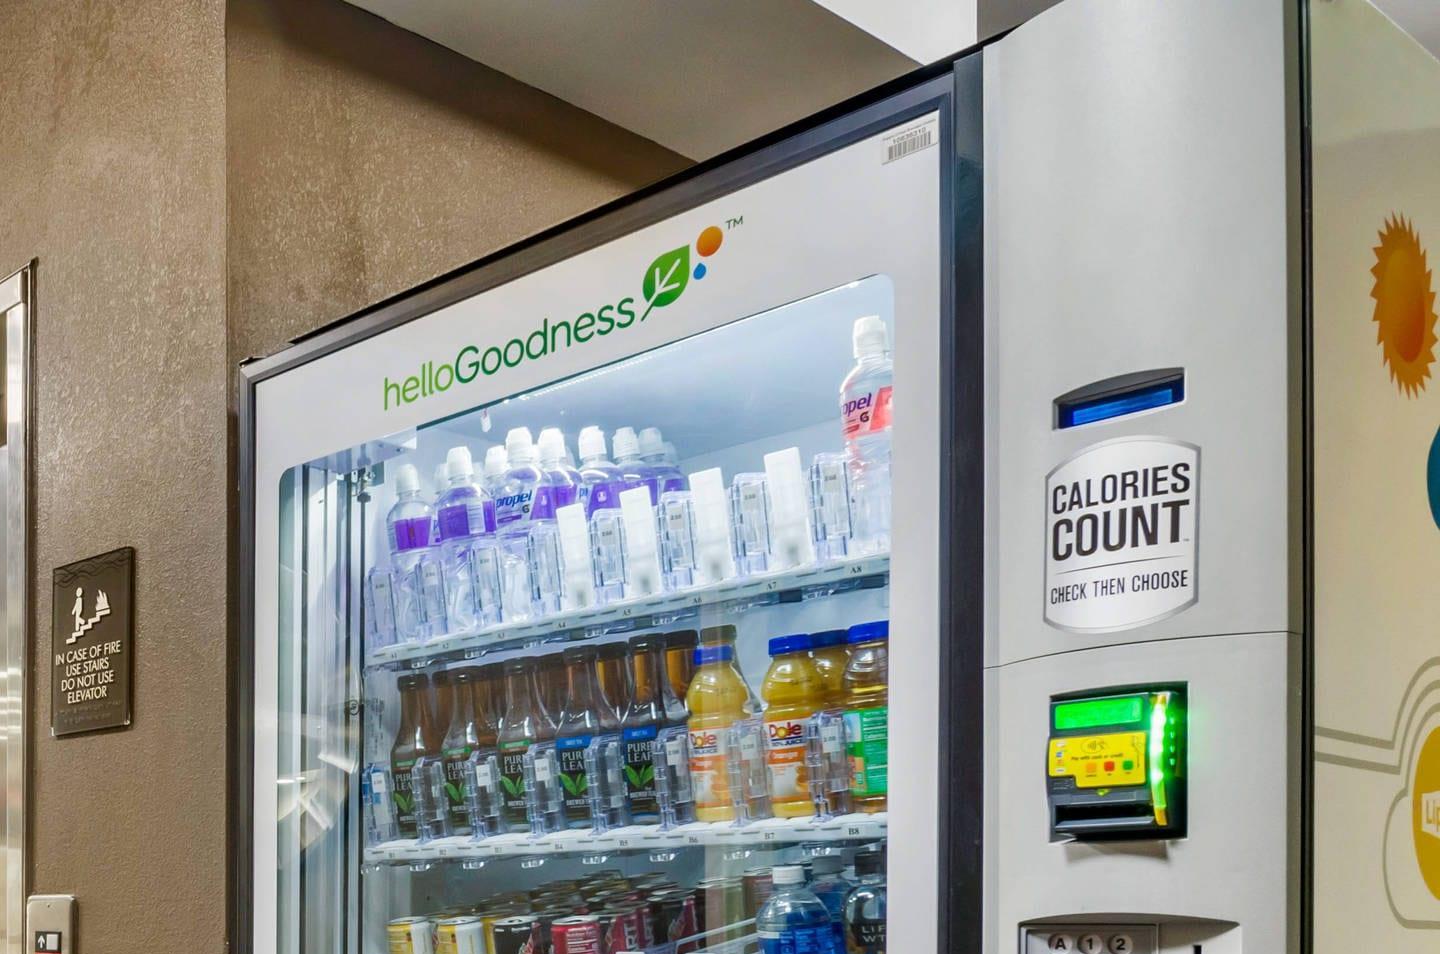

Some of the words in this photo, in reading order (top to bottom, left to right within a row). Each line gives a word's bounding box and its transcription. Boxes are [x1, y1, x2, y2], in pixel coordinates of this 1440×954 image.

[384, 297, 635, 410] helloGoodness
[1052, 462, 1191, 515] CALORIES
[1052, 499, 1190, 562] COUNT
[766, 581, 777, 590] A7
[849, 565, 862, 575] A8
[1050, 583, 1087, 605] CHECK
[1093, 577, 1125, 597] THEN
[1132, 569, 1188, 593] CHOOSE
[55, 653, 65, 666] IN
[66, 648, 88, 663] CASE
[89, 644, 102, 658] OF
[103, 640, 121, 655] FIRE
[66, 663, 82, 677] USE
[83, 657, 109, 674] STAIRS
[61, 678, 75, 692] DO
[77, 673, 96, 688] NOT
[97, 670, 114, 685] USE
[67, 685, 107, 705] ELEVATOR
[768, 722, 802, 739] Dole
[688, 836, 699, 844] B6
[764, 832, 775, 840] B7
[848, 827, 860, 836] B8
[1055, 938, 1066, 950] A
[1086, 938, 1093, 950] 1
[1116, 939, 1125, 950] 2
